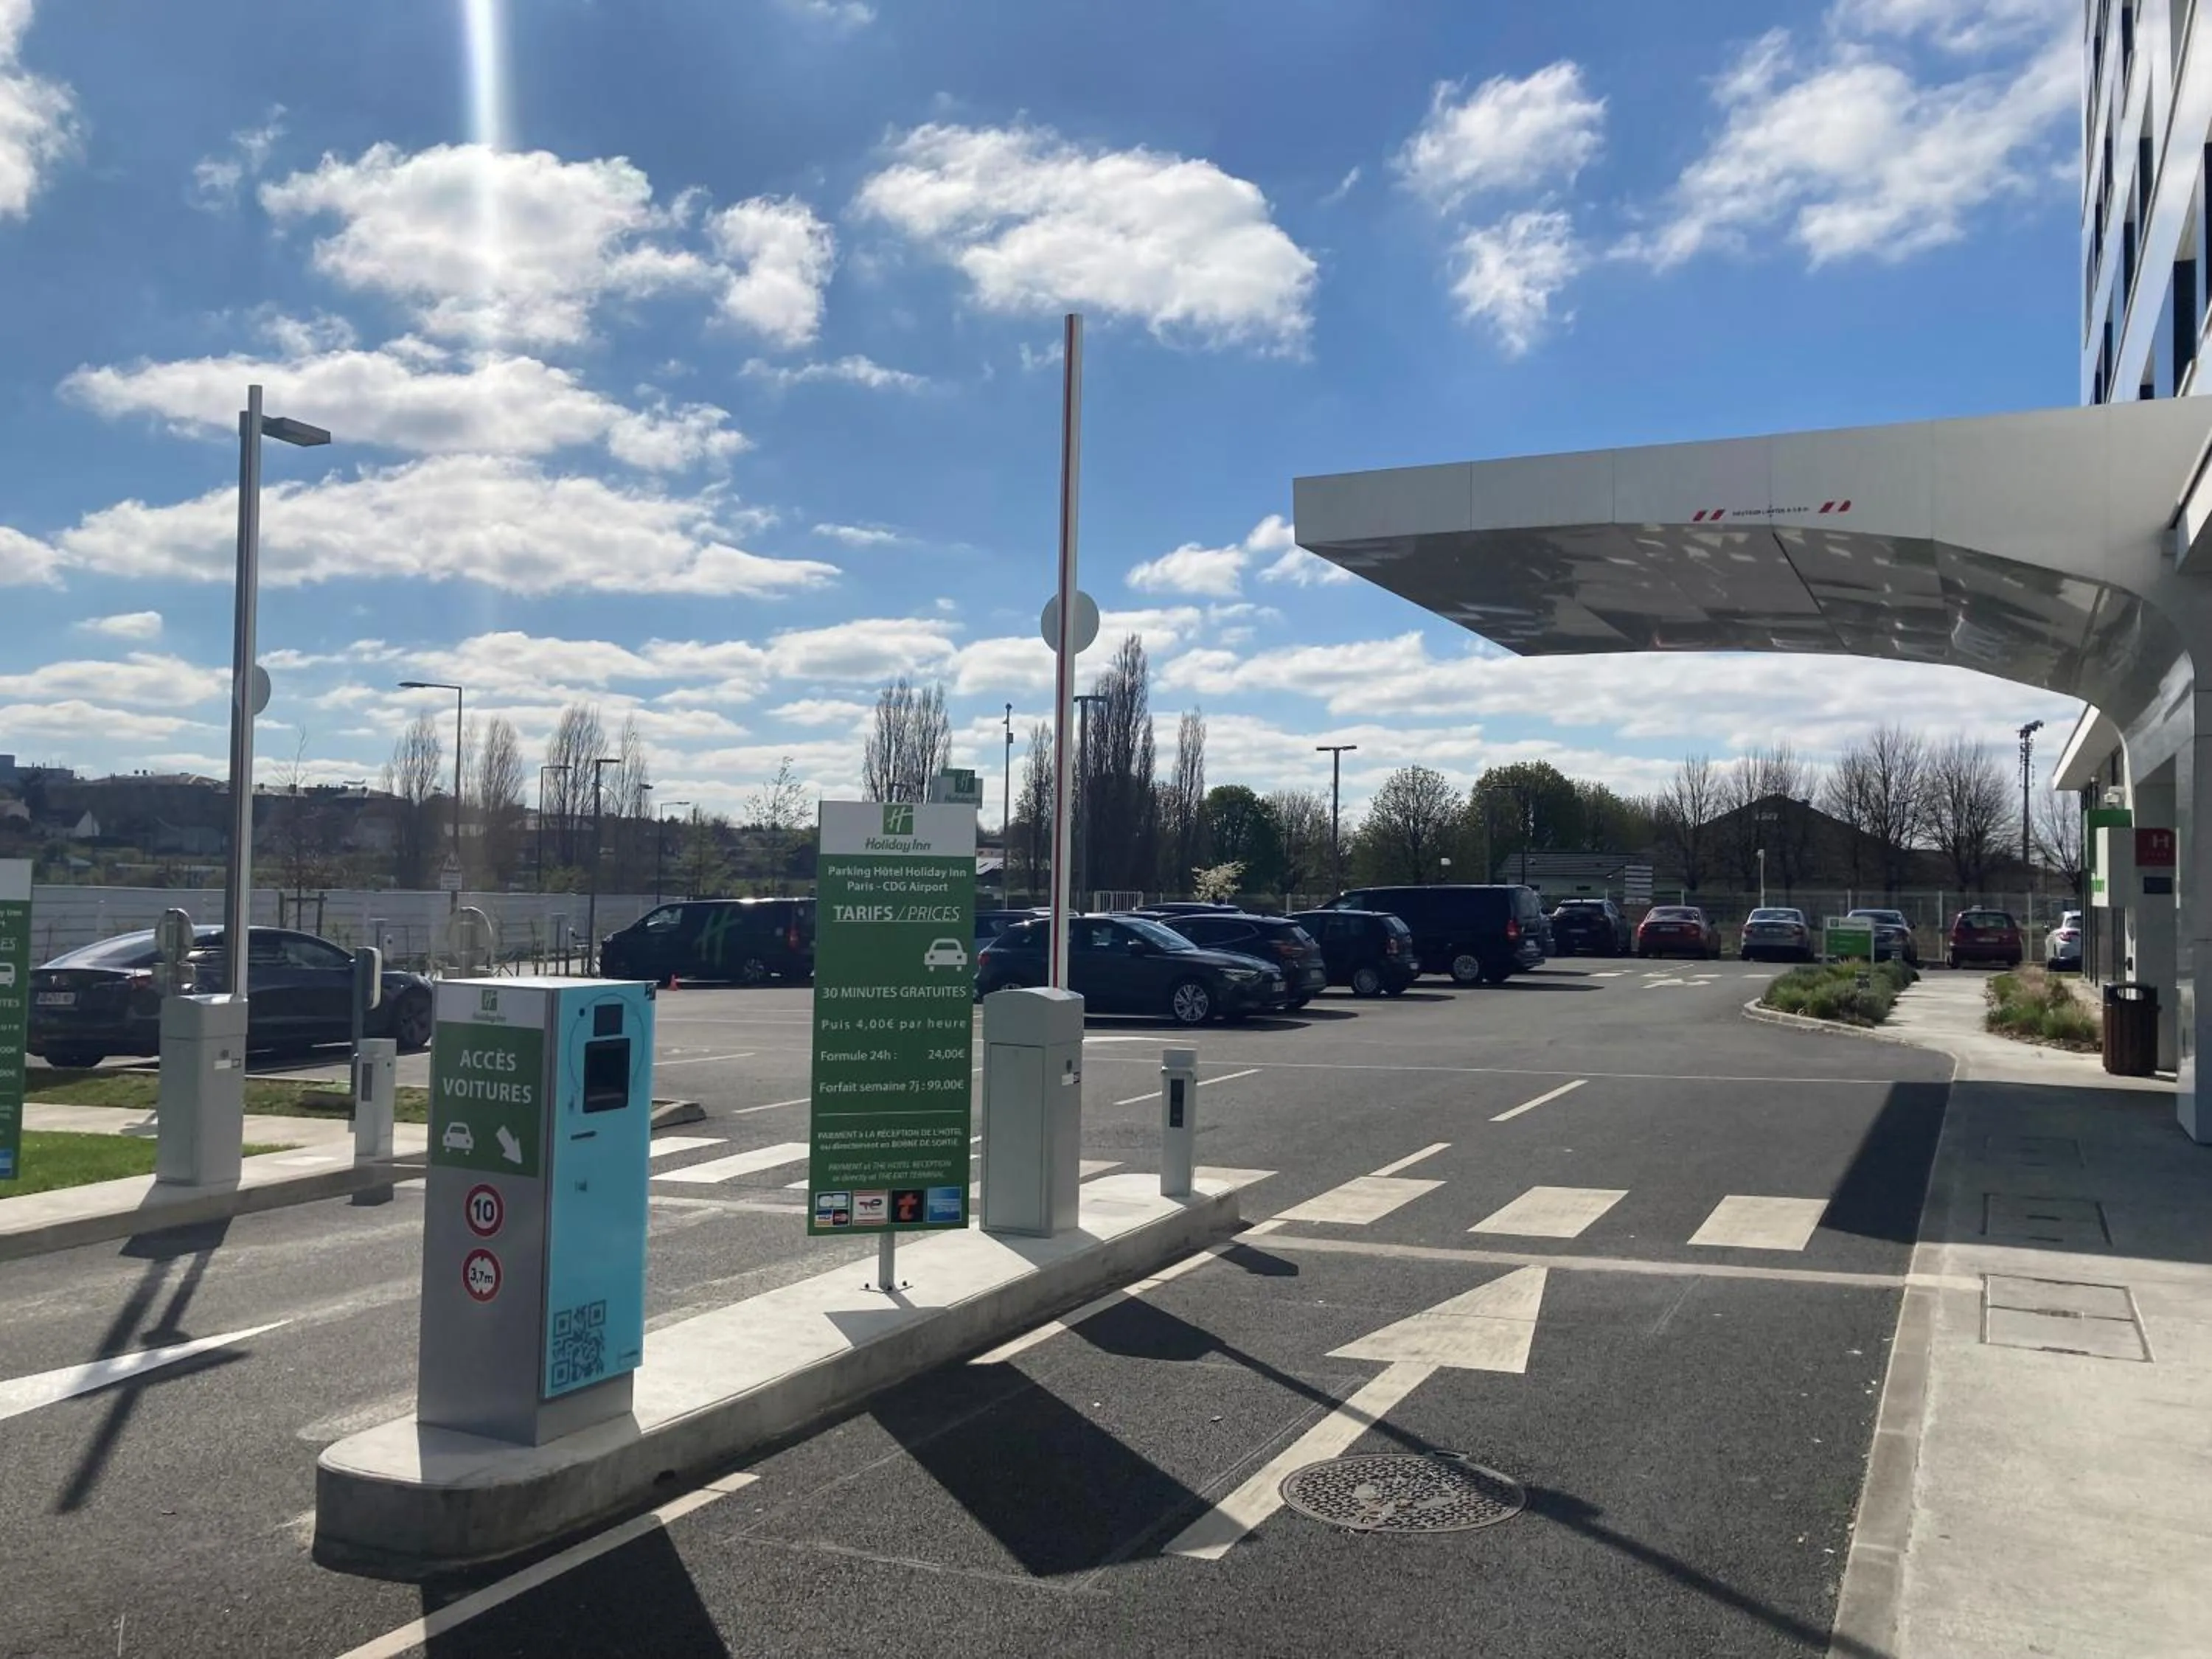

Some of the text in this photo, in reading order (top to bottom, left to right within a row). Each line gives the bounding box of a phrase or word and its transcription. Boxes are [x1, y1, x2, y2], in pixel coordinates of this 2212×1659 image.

[865, 838, 931, 852] Holiday Inn
[828, 866, 967, 879] Parking Hôtel Holiday Inn
[847, 881, 874, 891] Paris
[883, 882, 906, 891] CDG
[908, 882, 948, 893] Airport
[833, 905, 893, 920] TARIFS
[908, 906, 961, 921] PRICES
[823, 986, 967, 998] 30 MINUTES GRATUITES
[821, 1018, 967, 1030] Puis 4,00€ par heure
[459, 1048, 517, 1071] ACCÈS
[821, 1050, 868, 1060] Formule
[869, 1050, 891, 1060] 24h
[928, 1049, 965, 1060] 24,00€
[442, 1077, 532, 1104] VOITURES
[819, 1082, 857, 1093] Forfait
[860, 1082, 905, 1092] semaine
[927, 1079, 964, 1091] 99,00€
[473, 1199, 495, 1222] 10
